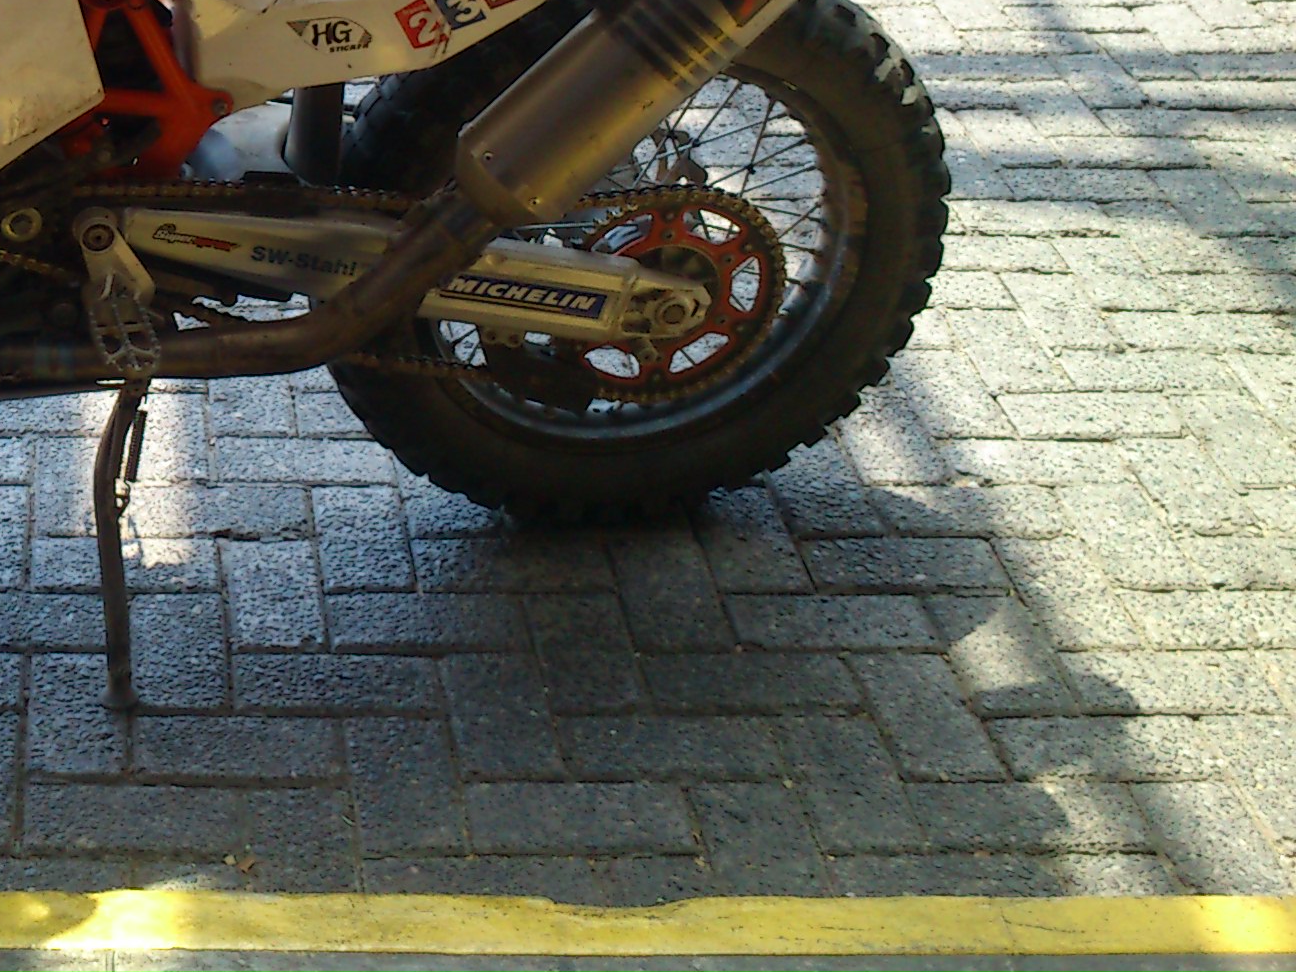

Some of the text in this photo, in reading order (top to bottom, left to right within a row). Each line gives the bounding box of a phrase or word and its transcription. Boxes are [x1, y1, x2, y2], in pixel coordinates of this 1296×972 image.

[311, 20, 353, 46] HG
[407, 10, 440, 45] 2
[250, 246, 358, 276] SW-Stahl
[447, 278, 597, 311] MICHELIN
